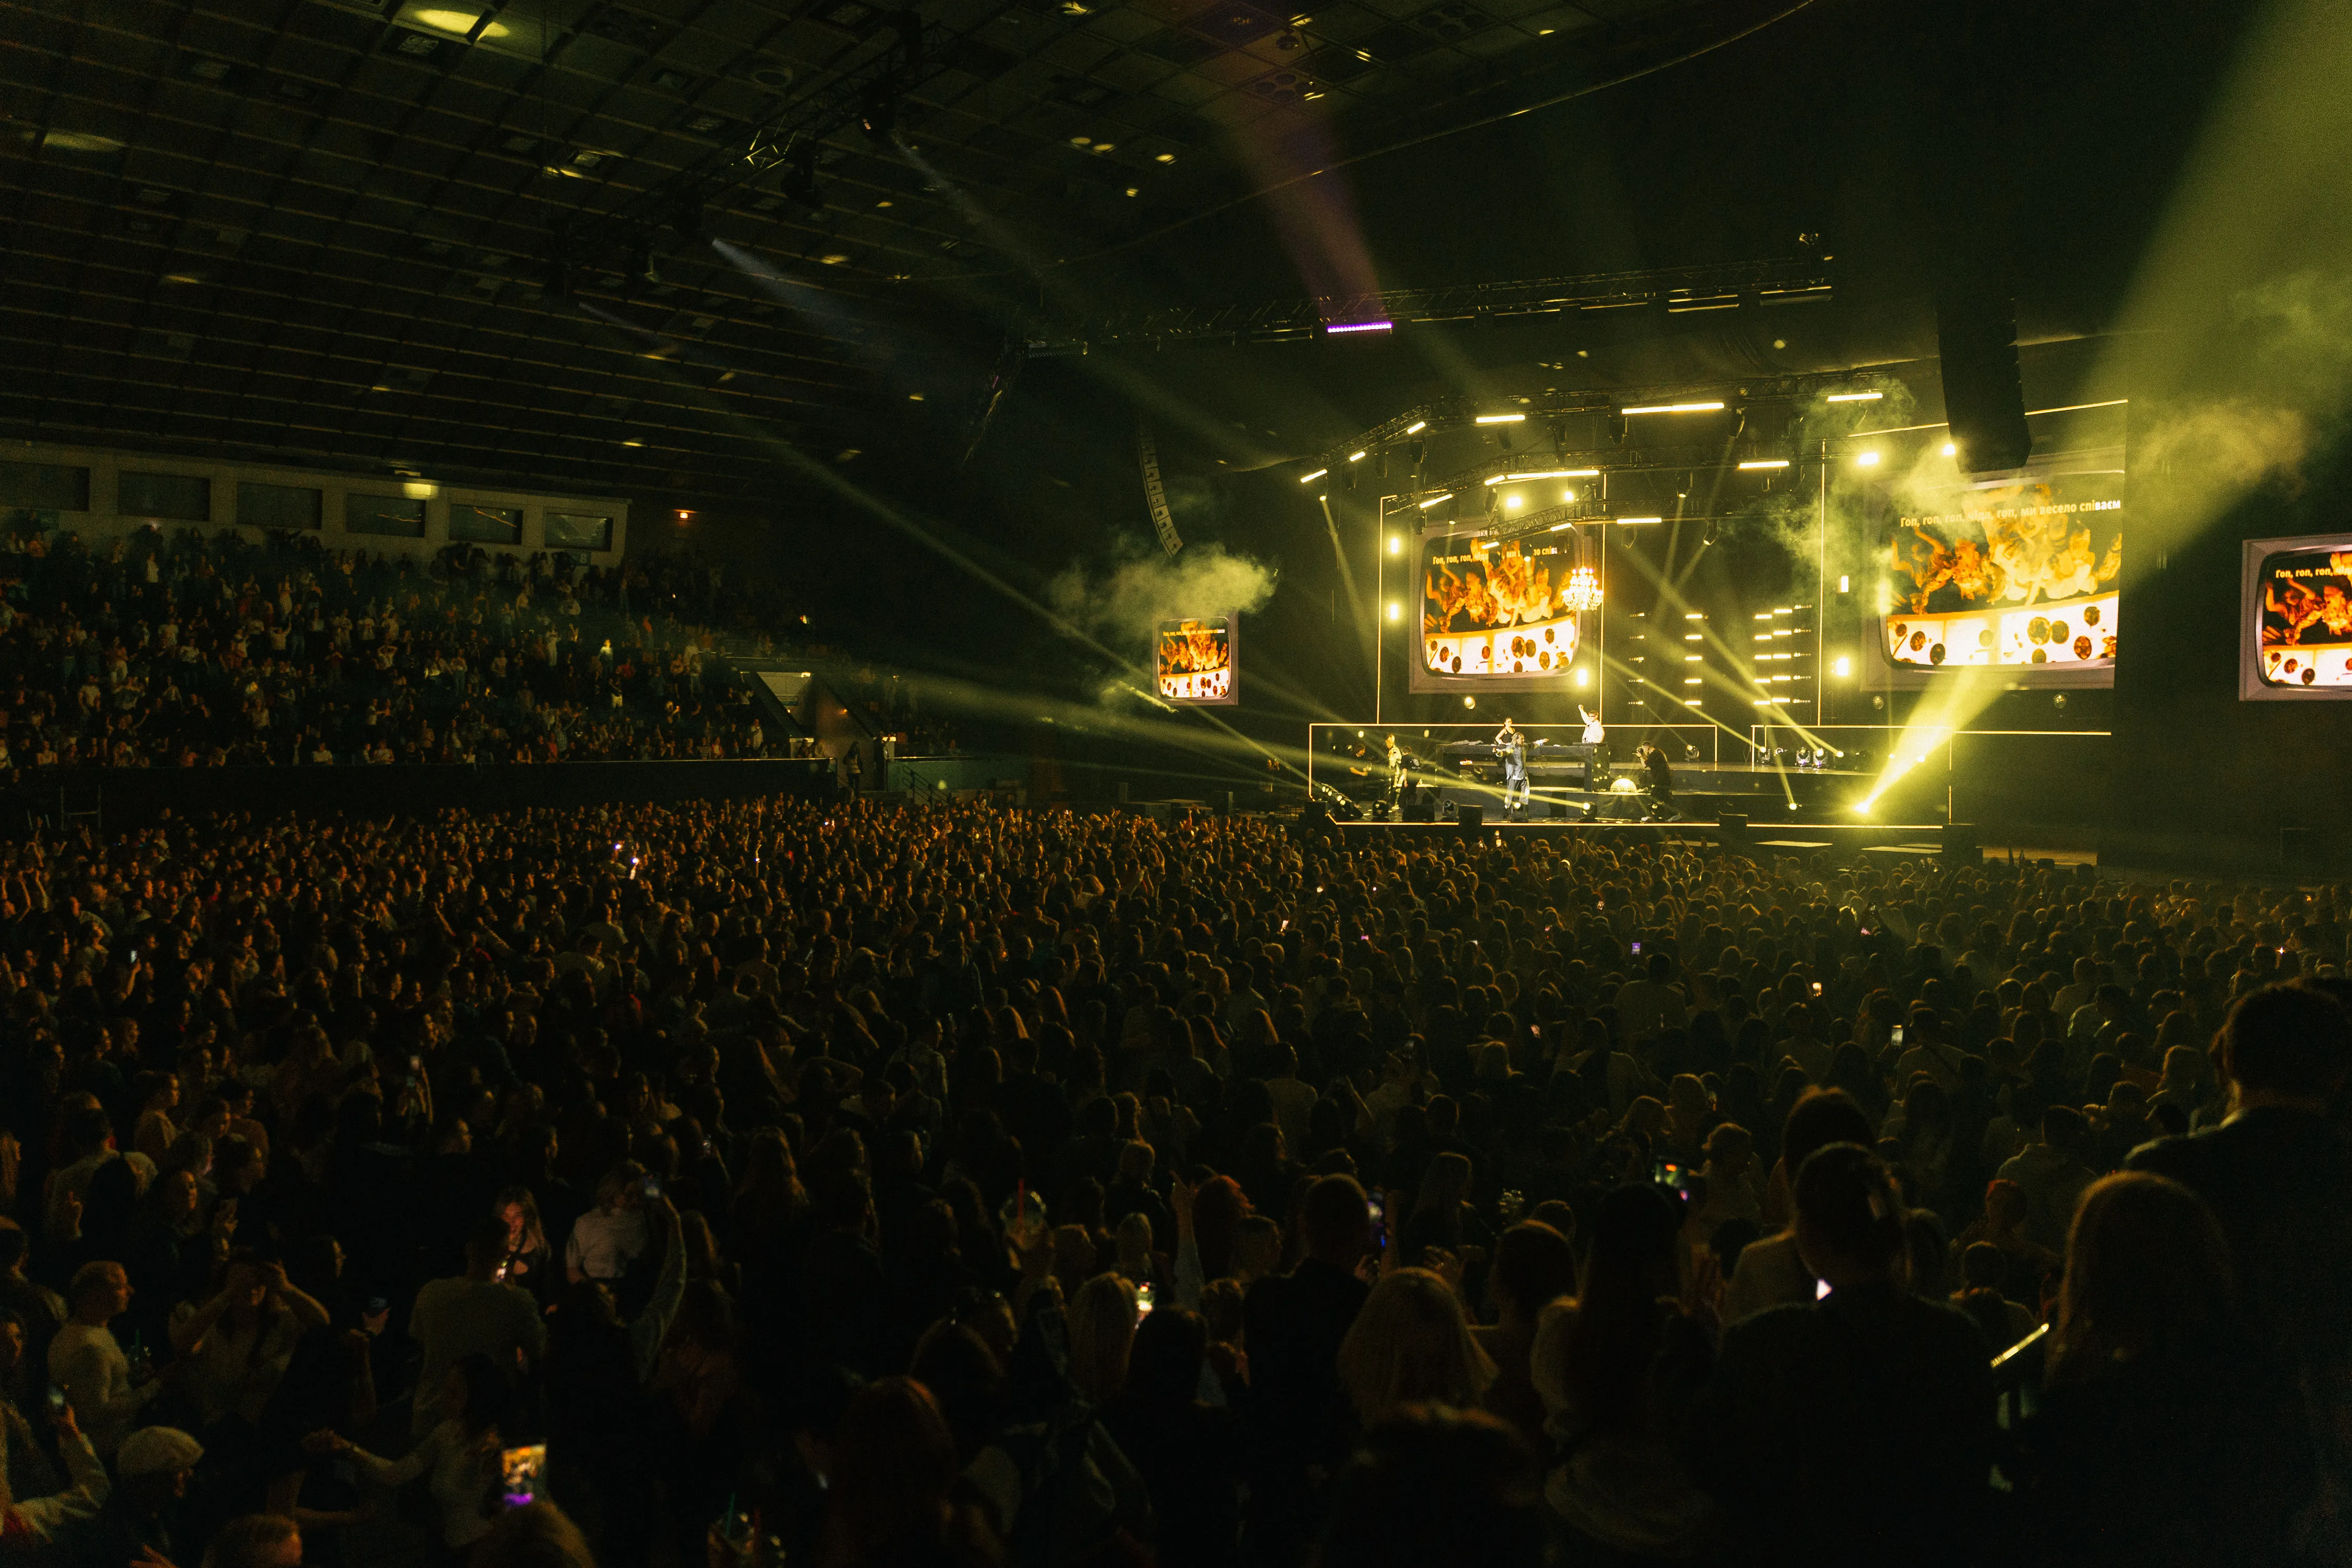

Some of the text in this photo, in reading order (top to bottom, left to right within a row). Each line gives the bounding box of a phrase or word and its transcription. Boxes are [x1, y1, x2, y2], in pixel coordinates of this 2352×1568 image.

[1922, 515, 1942, 525] гоп,
[2021, 508, 2036, 516] ми
[2040, 503, 2077, 515] весело
[2079, 500, 2120, 512] співаєм
[2296, 569, 2313, 577] гоп,
[2315, 568, 2333, 577] гоп,
